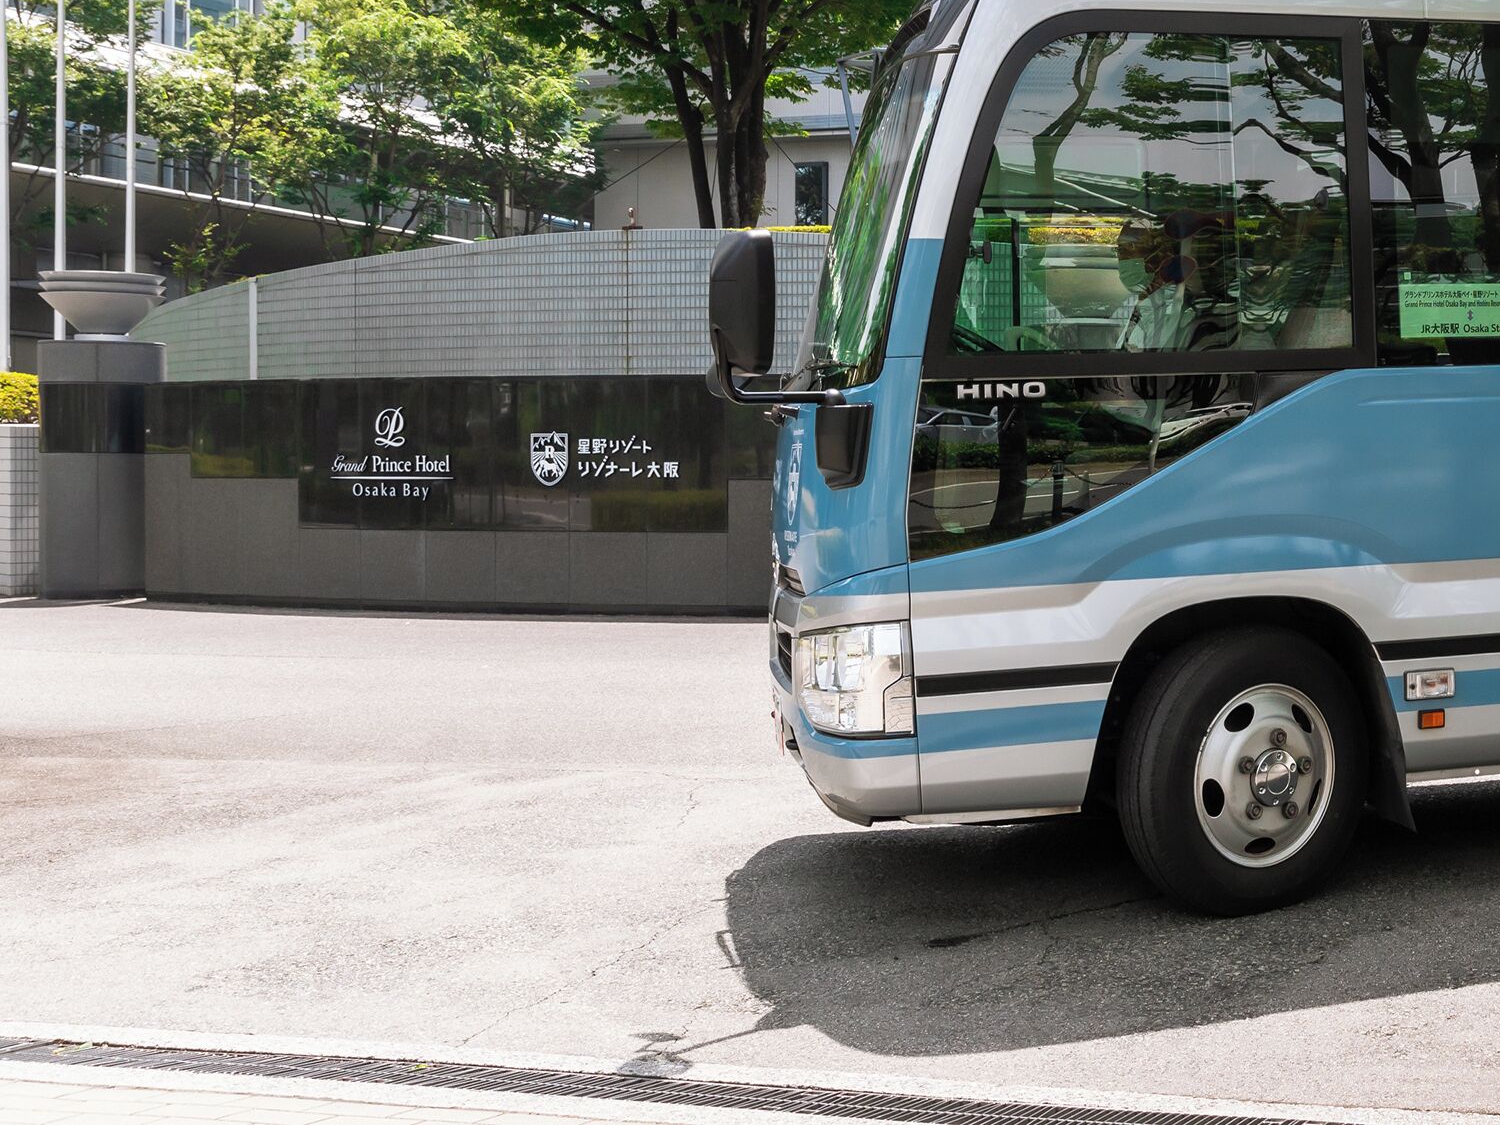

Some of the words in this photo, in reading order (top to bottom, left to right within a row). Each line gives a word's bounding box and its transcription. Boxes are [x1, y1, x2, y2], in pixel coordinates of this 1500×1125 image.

[1404, 300, 1419, 308] Grand
[1419, 300, 1433, 308] Prince
[1459, 300, 1468, 309] Bay
[1420, 323, 1460, 334] JR大阪駅
[1463, 323, 1490, 333] Osaka
[956, 381, 1046, 400] HINO
[577, 435, 652, 455] 星野リゾート
[331, 452, 369, 473] Grand
[371, 455, 412, 473] Prince
[415, 454, 450, 473] Hotel
[577, 456, 680, 479] リゾナーレ大阪
[352, 482, 396, 497] Osaka
[402, 482, 430, 501] Bay
